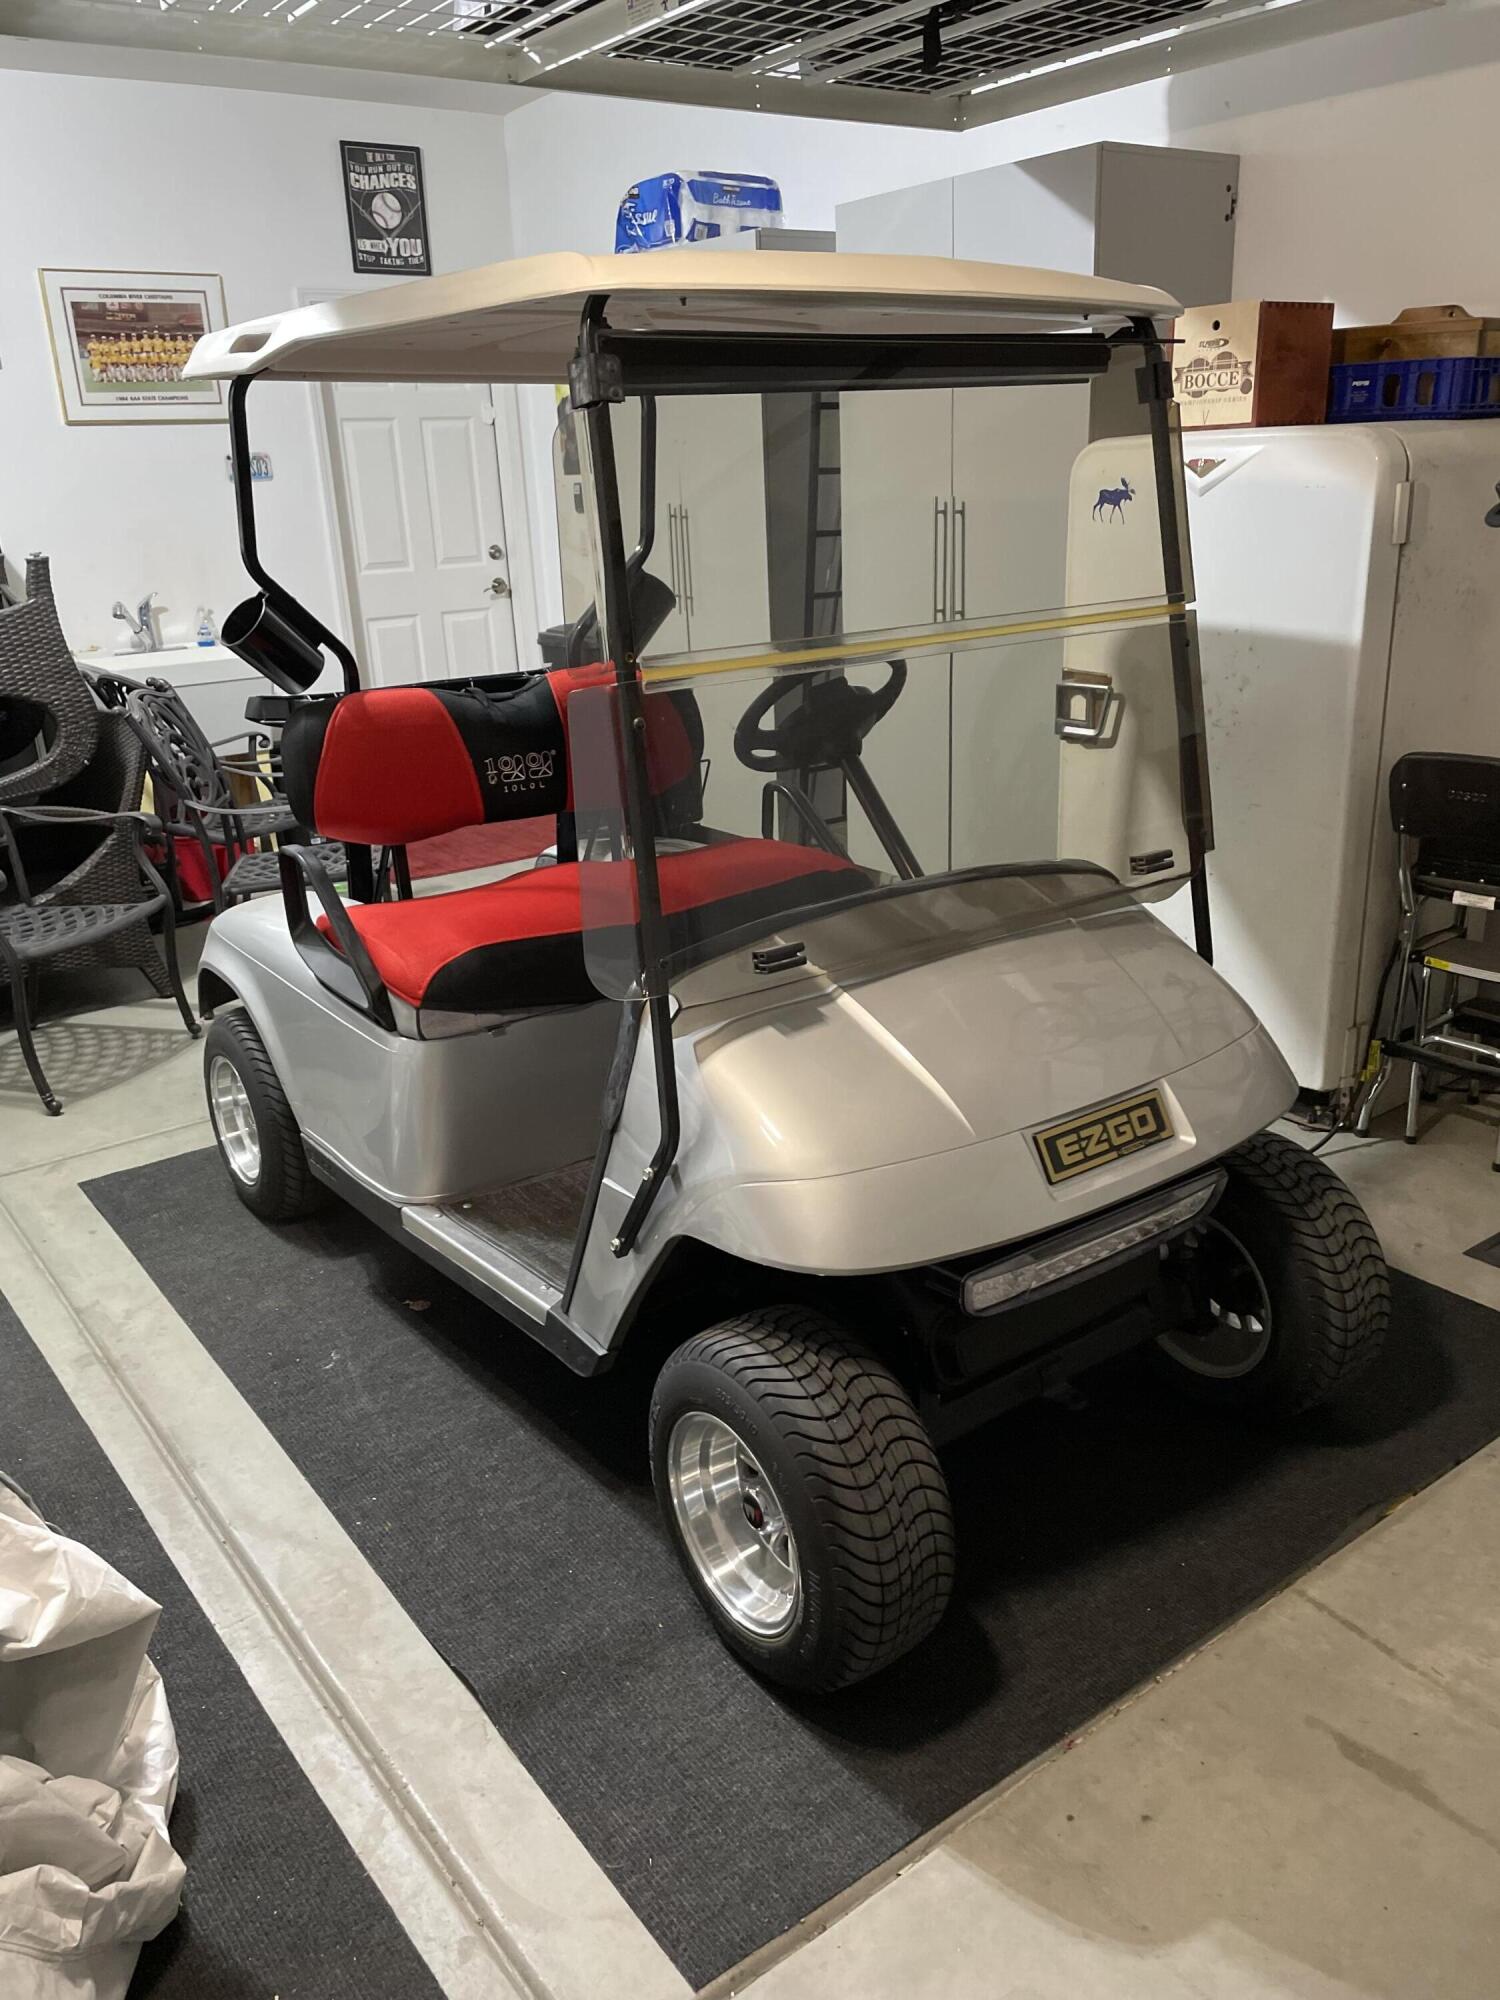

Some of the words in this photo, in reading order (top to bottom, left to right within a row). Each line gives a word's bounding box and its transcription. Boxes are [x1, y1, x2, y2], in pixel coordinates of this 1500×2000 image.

[349, 172, 417, 191] CHANCES
[386, 237, 423, 257] YOU
[1184, 371, 1239, 390] BOCCE
